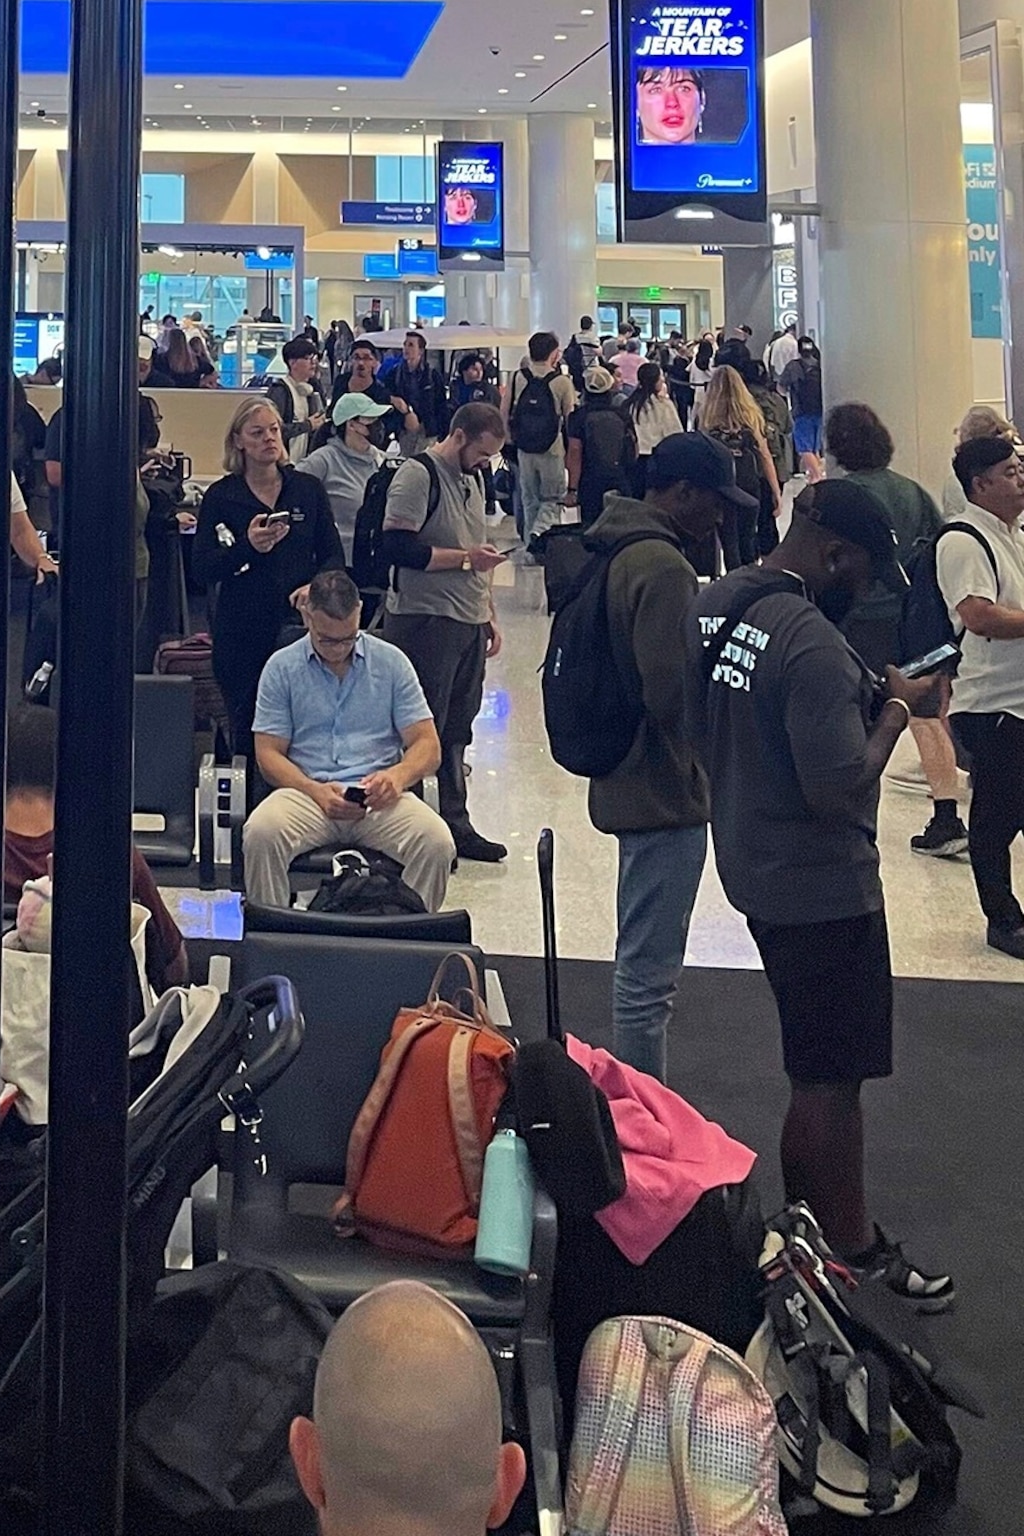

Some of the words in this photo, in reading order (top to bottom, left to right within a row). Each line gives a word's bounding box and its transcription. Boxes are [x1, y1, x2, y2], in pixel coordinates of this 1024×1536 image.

[652, 7, 661, 16] A
[662, 7, 716, 16] MOUNTAIN
[716, 7, 732, 16] OF
[659, 18, 723, 37] TEAR
[636, 36, 744, 56] JERKERS
[967, 223, 998, 241] ou
[403, 239, 419, 250] 35
[969, 245, 996, 265] nly
